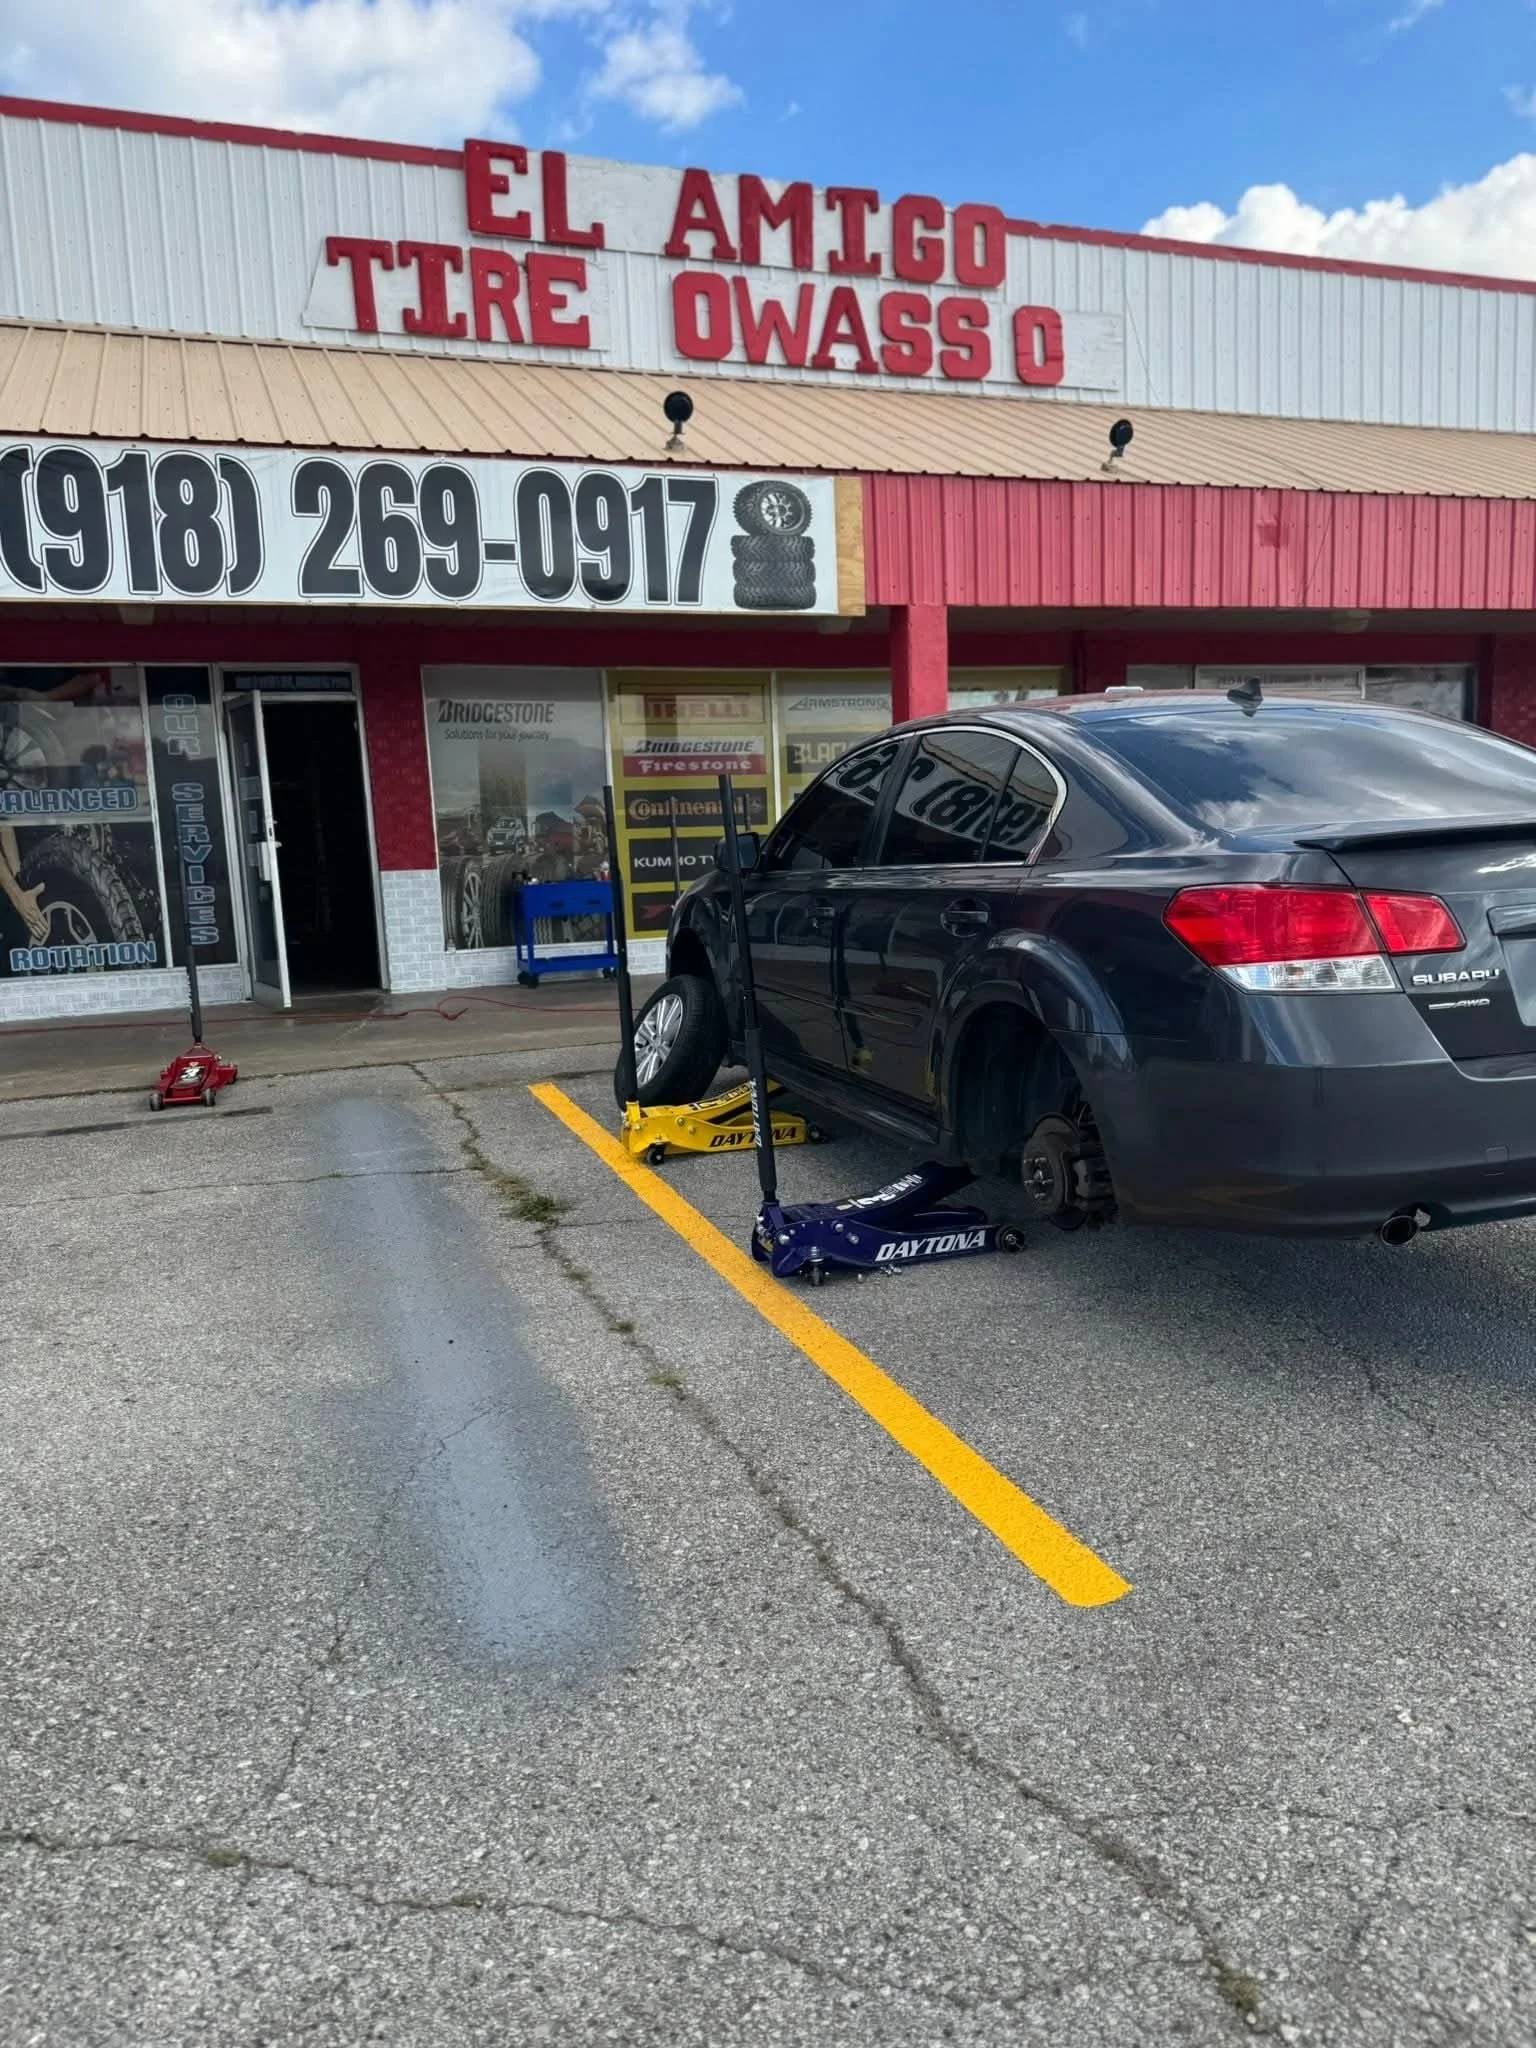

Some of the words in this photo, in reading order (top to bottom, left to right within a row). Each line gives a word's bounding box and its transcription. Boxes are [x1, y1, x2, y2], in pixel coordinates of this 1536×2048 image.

[463, 138, 604, 248] EL
[665, 168, 1006, 288] AMIGO
[325, 236, 591, 347] TIRE
[0, 442, 266, 596] (918)
[290, 458, 719, 607] 269-0917
[438, 699, 554, 723] BRIDGESTONE
[633, 739, 754, 753] BRIDGESTONE
[792, 741, 852, 765] BLAC
[638, 759, 752, 773] Firestone
[0, 788, 137, 814] ALANCED
[629, 797, 745, 820] Continenl
[171, 782, 220, 945] SERVICES
[10, 941, 157, 972] ROTATION
[1412, 968, 1500, 986] SUBARU
[709, 1127, 797, 1148] DAYTNA
[875, 1230, 986, 1262] DAYTONA
